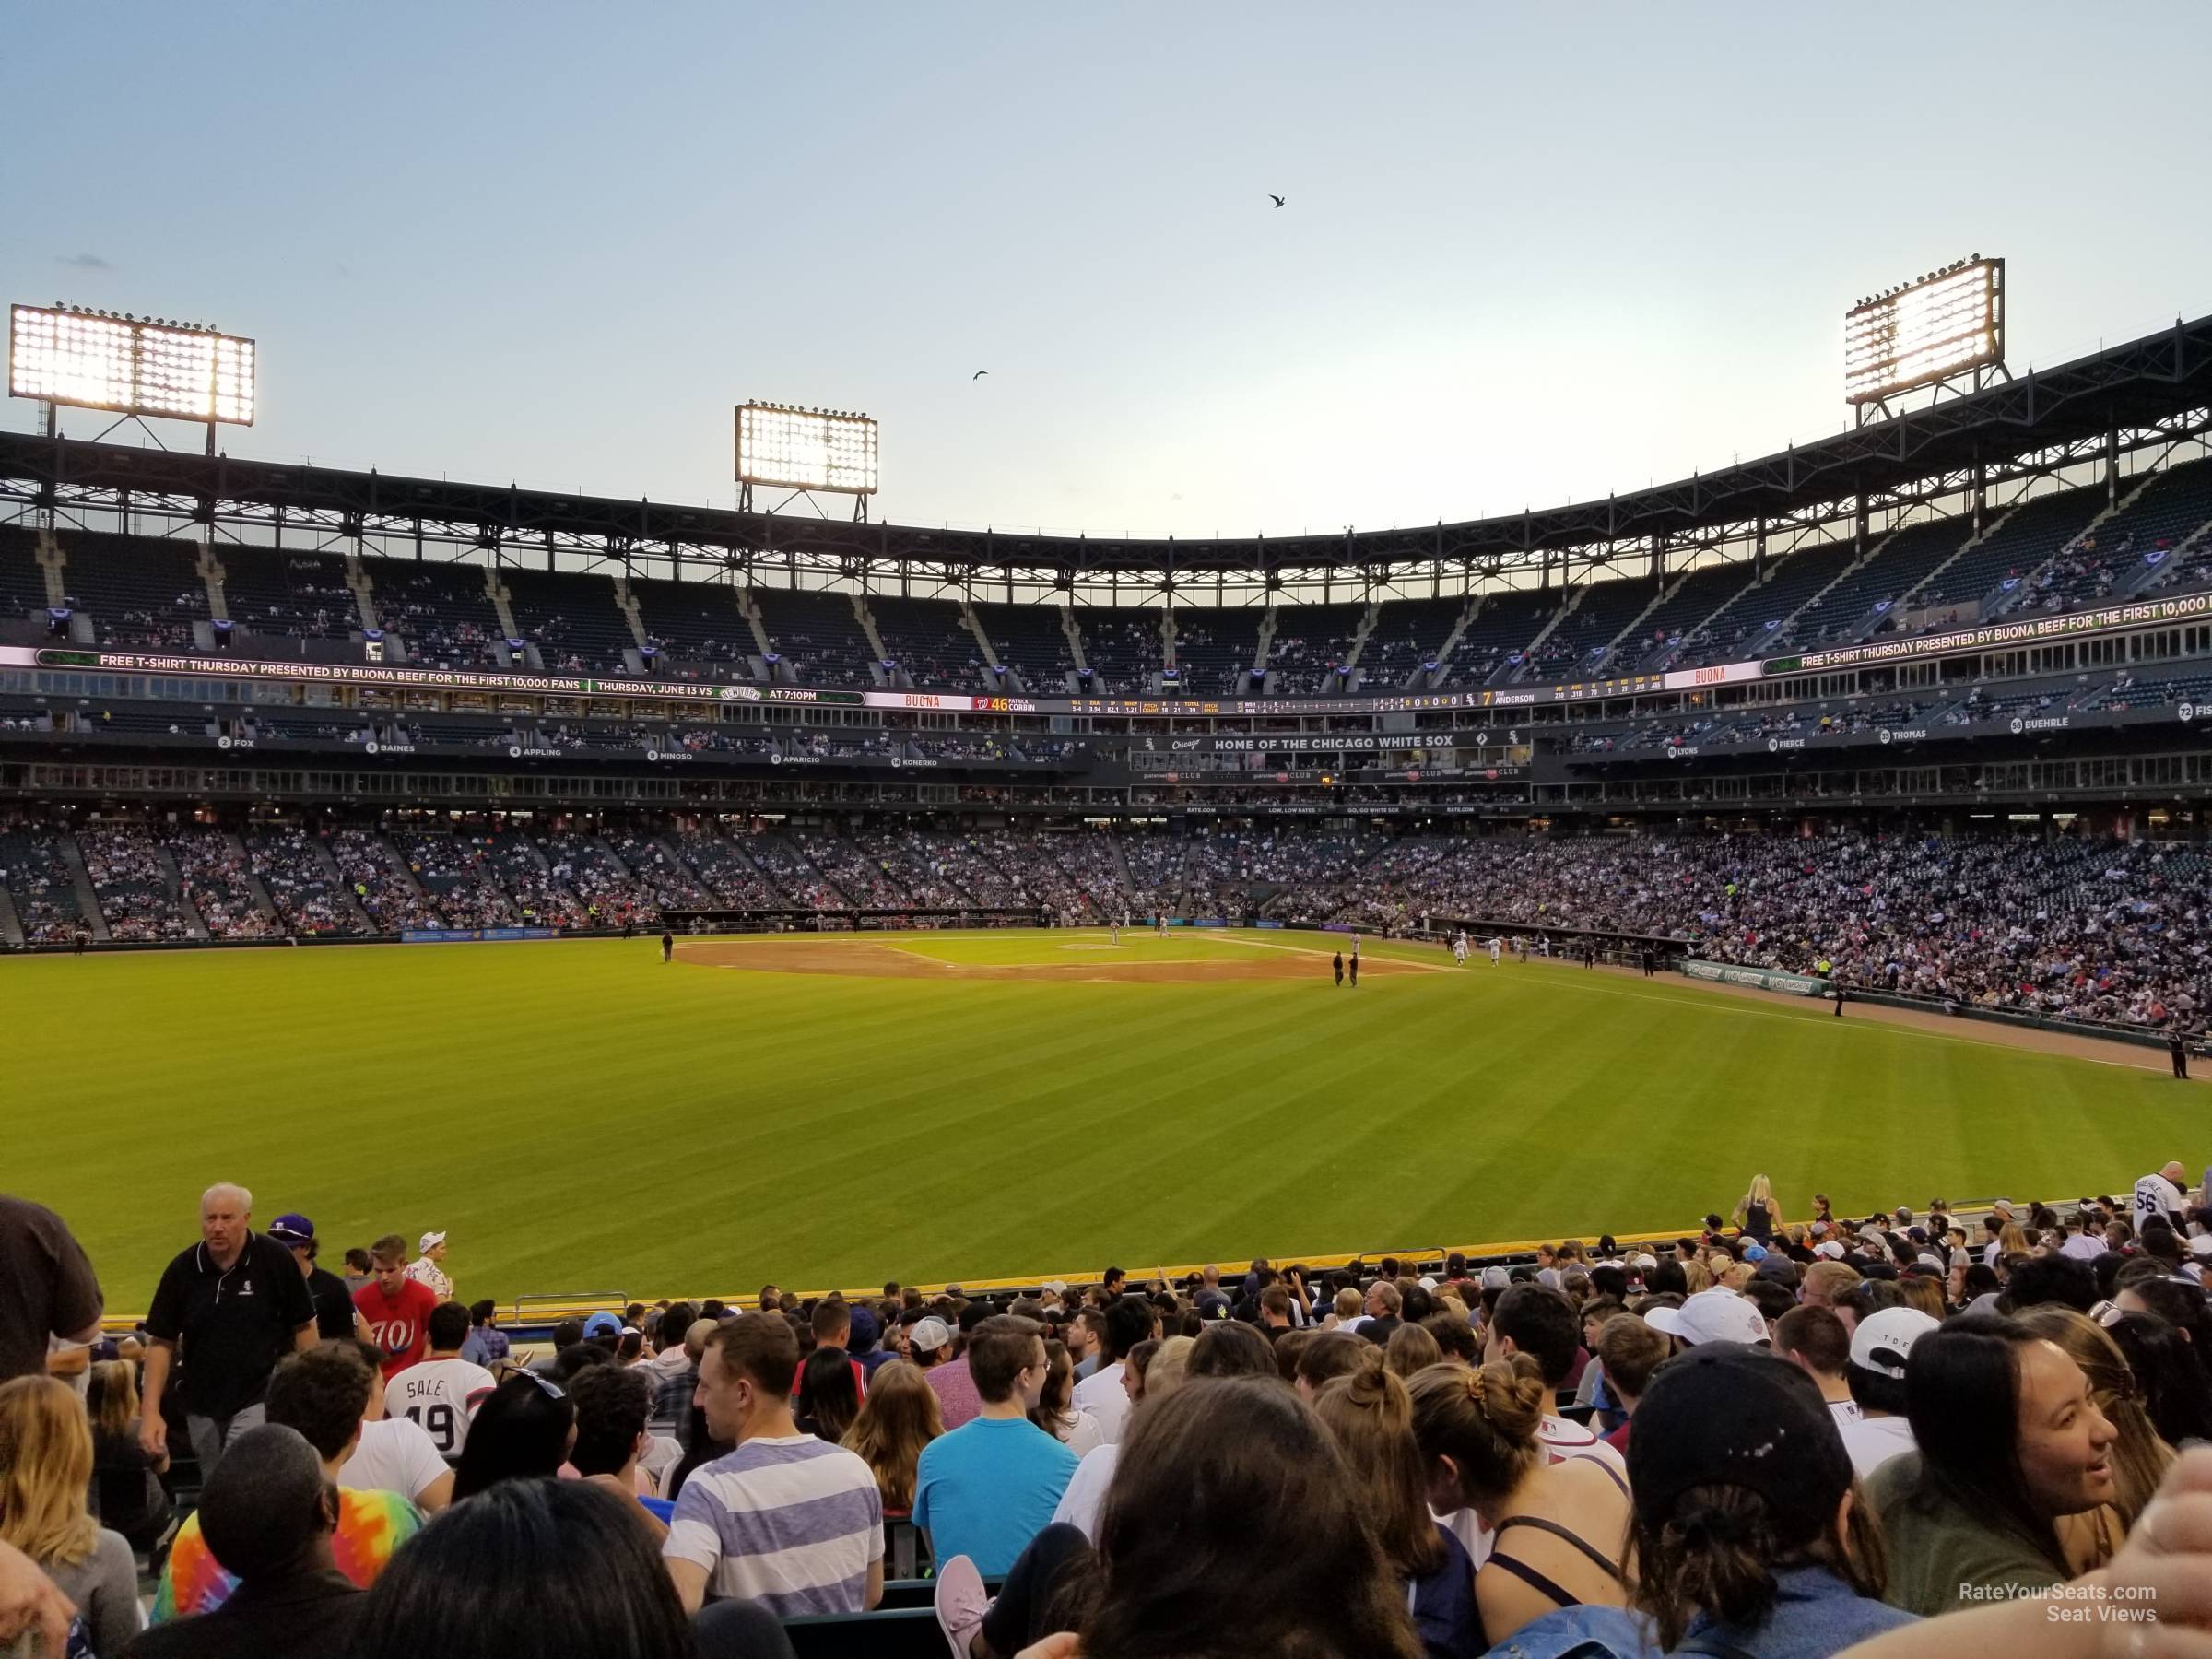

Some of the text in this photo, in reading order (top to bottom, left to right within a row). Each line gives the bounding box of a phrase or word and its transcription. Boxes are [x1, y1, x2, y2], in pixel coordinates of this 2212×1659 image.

[1802, 655, 1823, 667] FREE
[1825, 650, 1860, 665] T-SHIRT
[1863, 642, 1913, 659] THURSDAY
[1917, 634, 1974, 652] PRESENTED
[1977, 629, 1992, 643] BY
[1995, 624, 2035, 641] BUONA
[2037, 619, 2066, 635] BEEF
[2069, 613, 2093, 629] FOR
[2096, 609, 2120, 624] THE
[2123, 604, 2158, 622] FIRST
[2161, 597, 2206, 617] 10,000
[100, 655, 580, 690] FREE T-SHIRT THURSDAY PRESENTED BY BUONA BEEF FOR THE FIRST 10,000 FANS
[1696, 668, 1725, 684] BUONA
[597, 682, 817, 700] THURSDAY, JUNE 13 VS NEW YORK AT 7:10PM
[905, 694, 940, 708] BUONA
[991, 698, 1008, 711] 46
[1414, 698, 1420, 707] 0
[1433, 697, 1438, 706] 0
[1451, 696, 1457, 705] 0
[1483, 692, 1535, 706] 7 ANDERSON
[1008, 703, 1035, 712] CORBIN
[2180, 706, 2212, 717] 72 FIS
[2025, 717, 2069, 729] BUEHRLE
[1893, 729, 1927, 740] THOMAS
[1172, 739, 1201, 750] Chicago
[1215, 735, 1453, 750] HOME OF THE CHICAGO WHITE SOX
[1779, 739, 1805, 748] PIERCE
[1677, 747, 1698, 756] LYONS
[1725, 970, 1741, 981] WGN
[1769, 977, 1788, 989] WGN
[2137, 1190, 2156, 1213] 56
[407, 1379, 445, 1399] SALE
